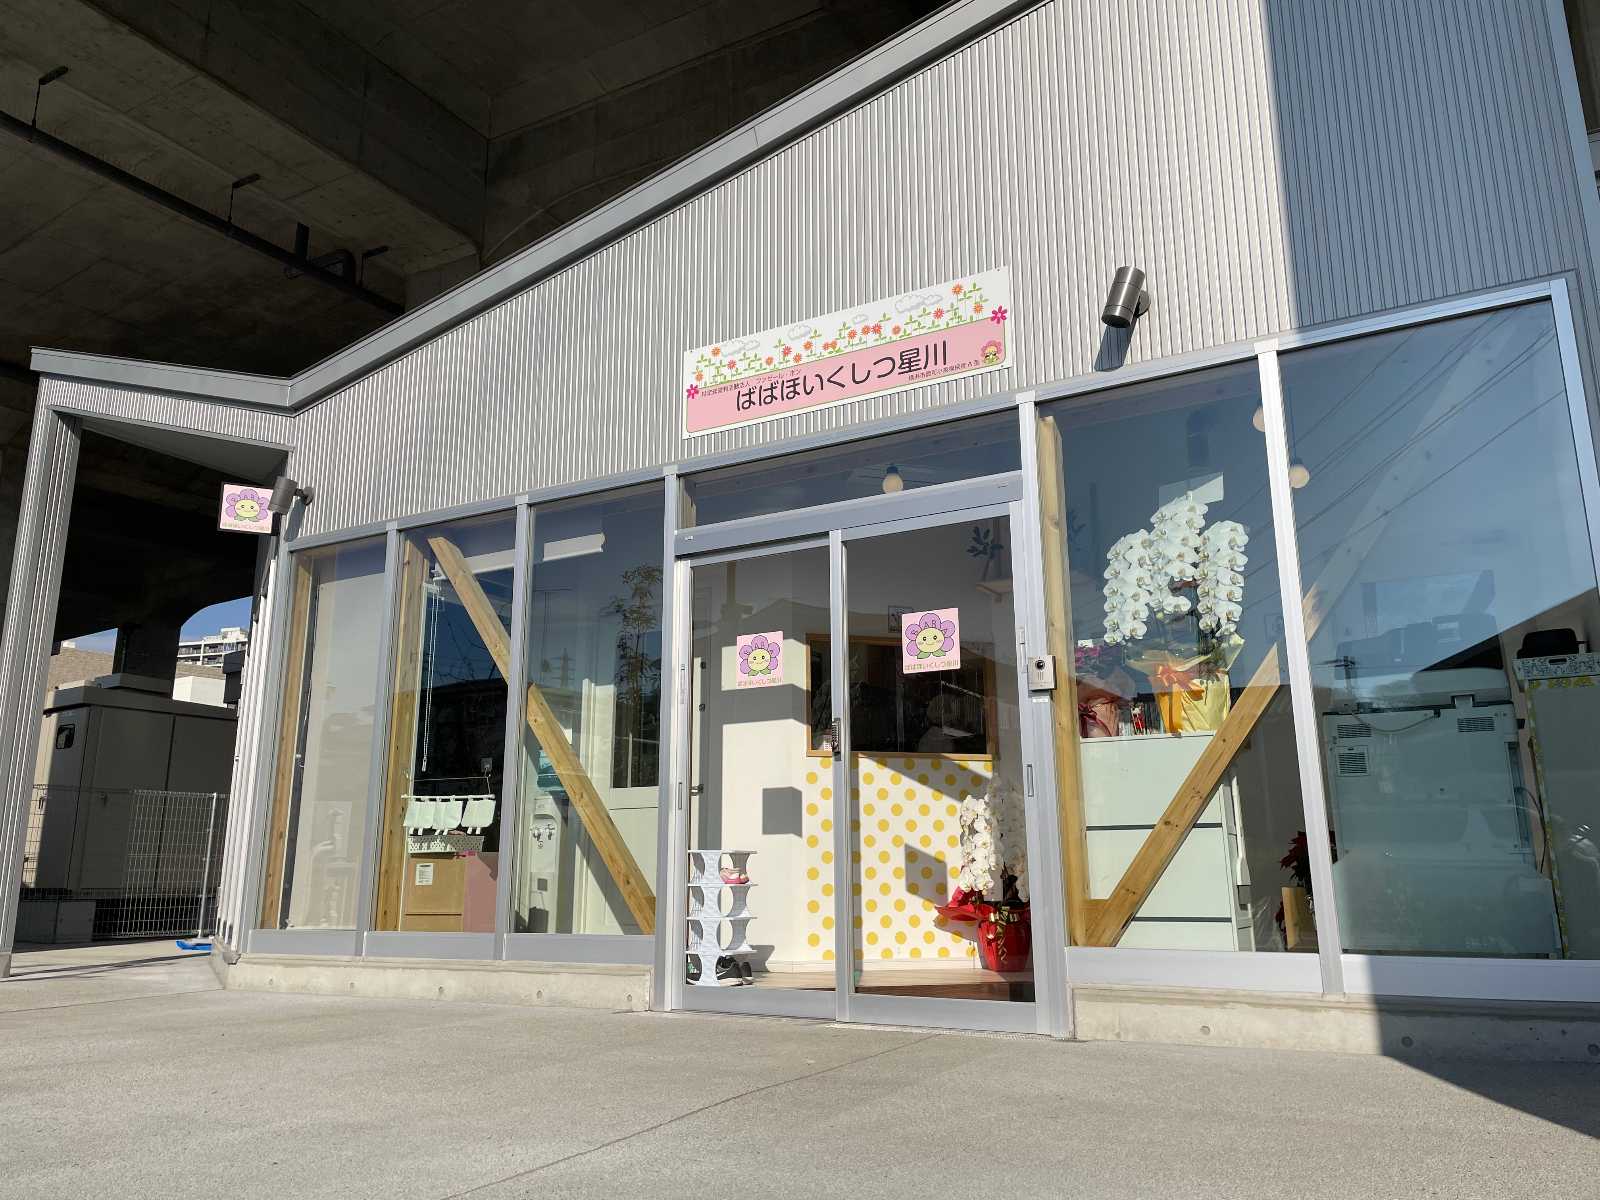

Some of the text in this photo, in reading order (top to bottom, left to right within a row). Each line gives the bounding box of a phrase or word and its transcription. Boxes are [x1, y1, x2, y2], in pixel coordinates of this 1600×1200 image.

[736, 340, 947, 411] ばばほいくしつ星川
